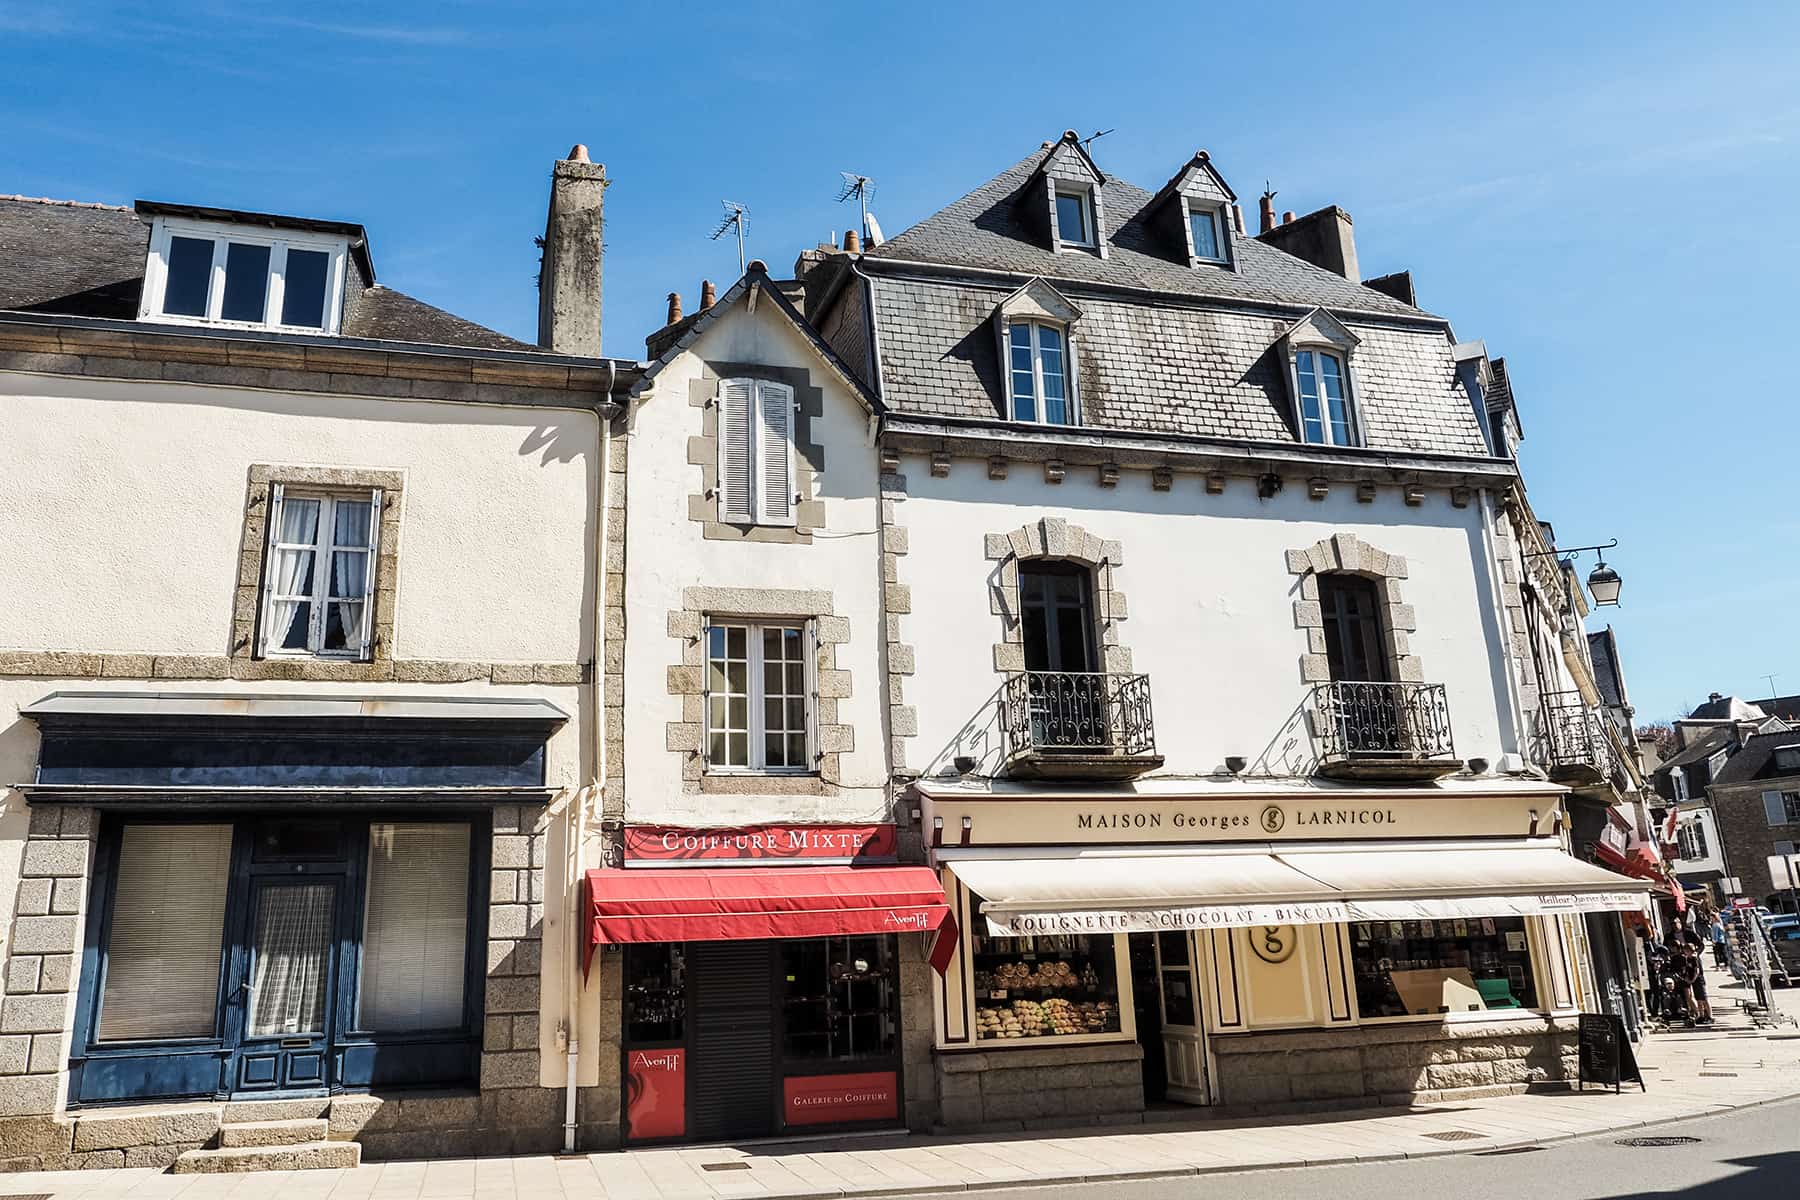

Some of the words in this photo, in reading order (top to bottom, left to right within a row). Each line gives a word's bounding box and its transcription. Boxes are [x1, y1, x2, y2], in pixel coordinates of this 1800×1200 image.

[1077, 813, 1161, 828] MAISON
[1173, 813, 1250, 830] Georges
[1297, 810, 1396, 825] LARNICOL
[1160, 910, 1254, 927] CHOCOLAT
